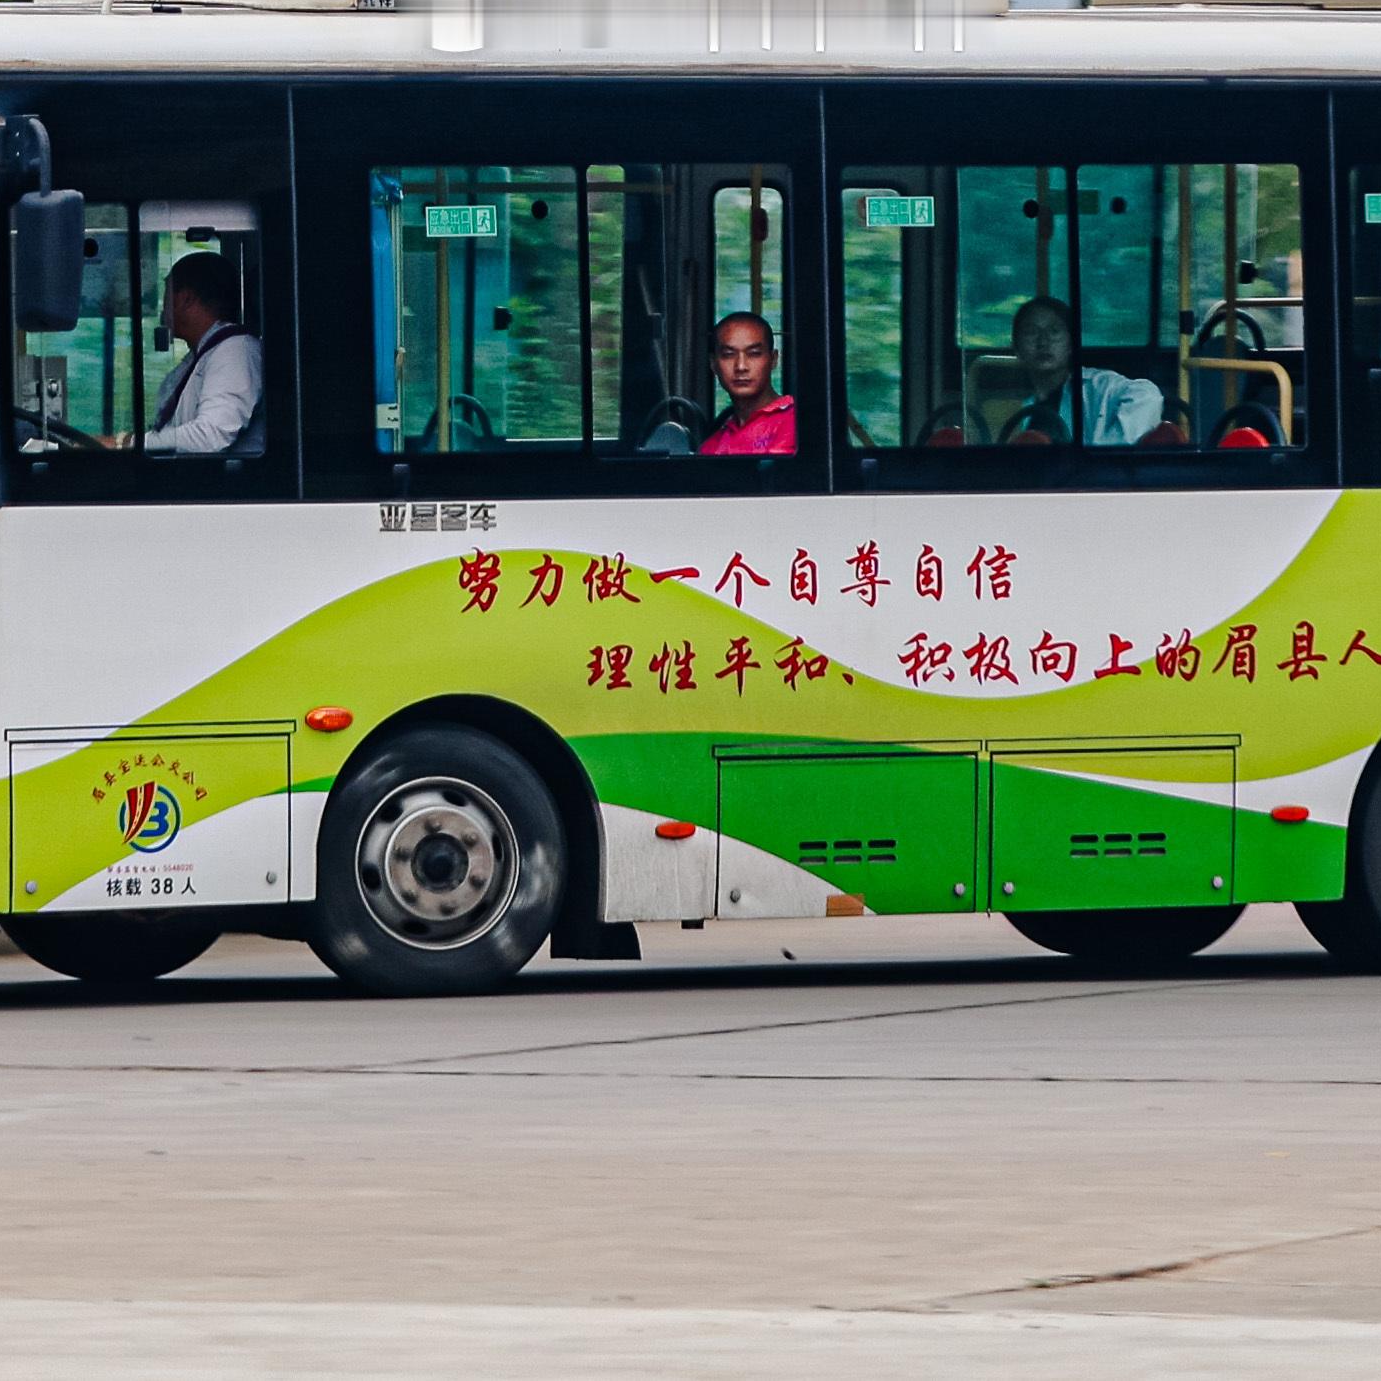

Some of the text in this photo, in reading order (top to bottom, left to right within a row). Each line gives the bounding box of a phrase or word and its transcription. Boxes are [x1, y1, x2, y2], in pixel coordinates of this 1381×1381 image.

[379, 502, 498, 533] 亚星客车
[458, 539, 1019, 614] 努力做一个自尊自信
[106, 876, 197, 897] 核载 38 人
